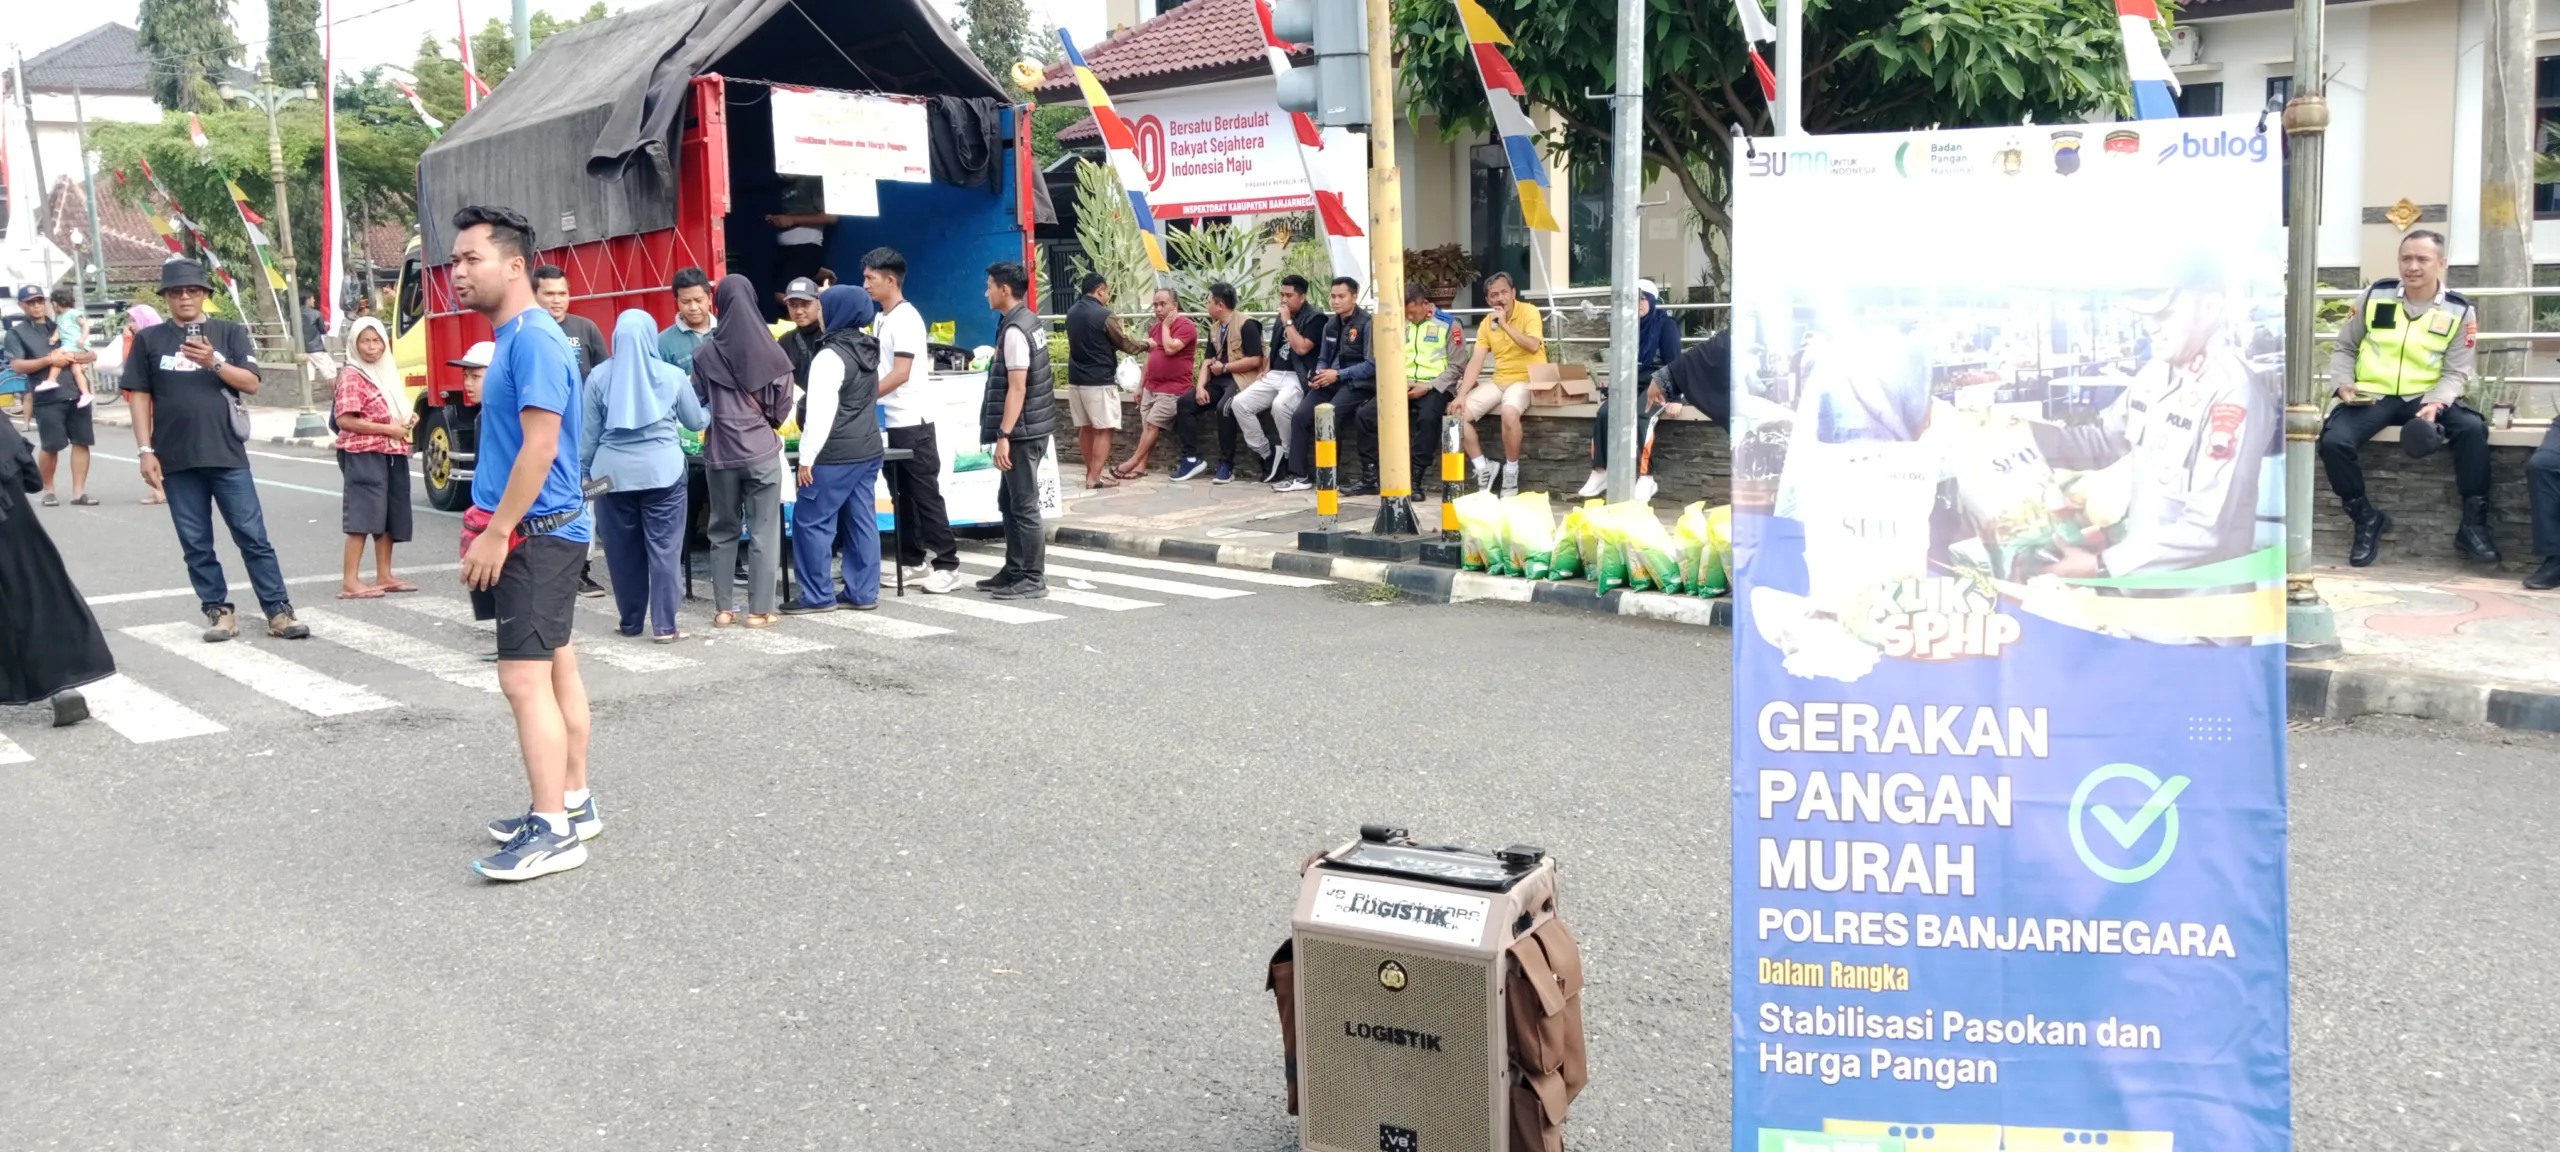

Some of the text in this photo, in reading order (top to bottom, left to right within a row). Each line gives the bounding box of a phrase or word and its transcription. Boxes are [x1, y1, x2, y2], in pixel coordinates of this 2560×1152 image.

[1170, 111, 1270, 136] Bersatu Berdaulat
[1171, 134, 1265, 159] Rakyat Sejahtera
[1830, 158, 1858, 167] UNTUK
[1931, 143, 1963, 152] Badan
[1931, 154, 1968, 164] Pangan
[2182, 130, 2268, 163] bulog
[1171, 157, 1253, 177] Indonesia Maju
[1830, 167, 1877, 175] INDONESIA
[1182, 202, 1227, 215] INSPEKTORAT
[1228, 199, 1268, 213] KABUPATEN
[2166, 412, 2193, 431] POLRI
[1884, 611, 2021, 658] SPHP
[1757, 701, 2049, 759] GERAKAN
[1758, 769, 2012, 828] PANGAN
[1758, 838, 1976, 897] MURAH
[1350, 894, 1449, 926] LOGISTIK
[1758, 907, 2236, 958] POLRES BANJARNEGARA
[1758, 956, 1909, 993] Dalam Rangka
[1345, 1020, 1443, 1053] LOGISTIK
[1758, 1002, 2161, 1049] Stabilisasi Pasokan dan
[1758, 1043, 1998, 1090] Harga Pangan
